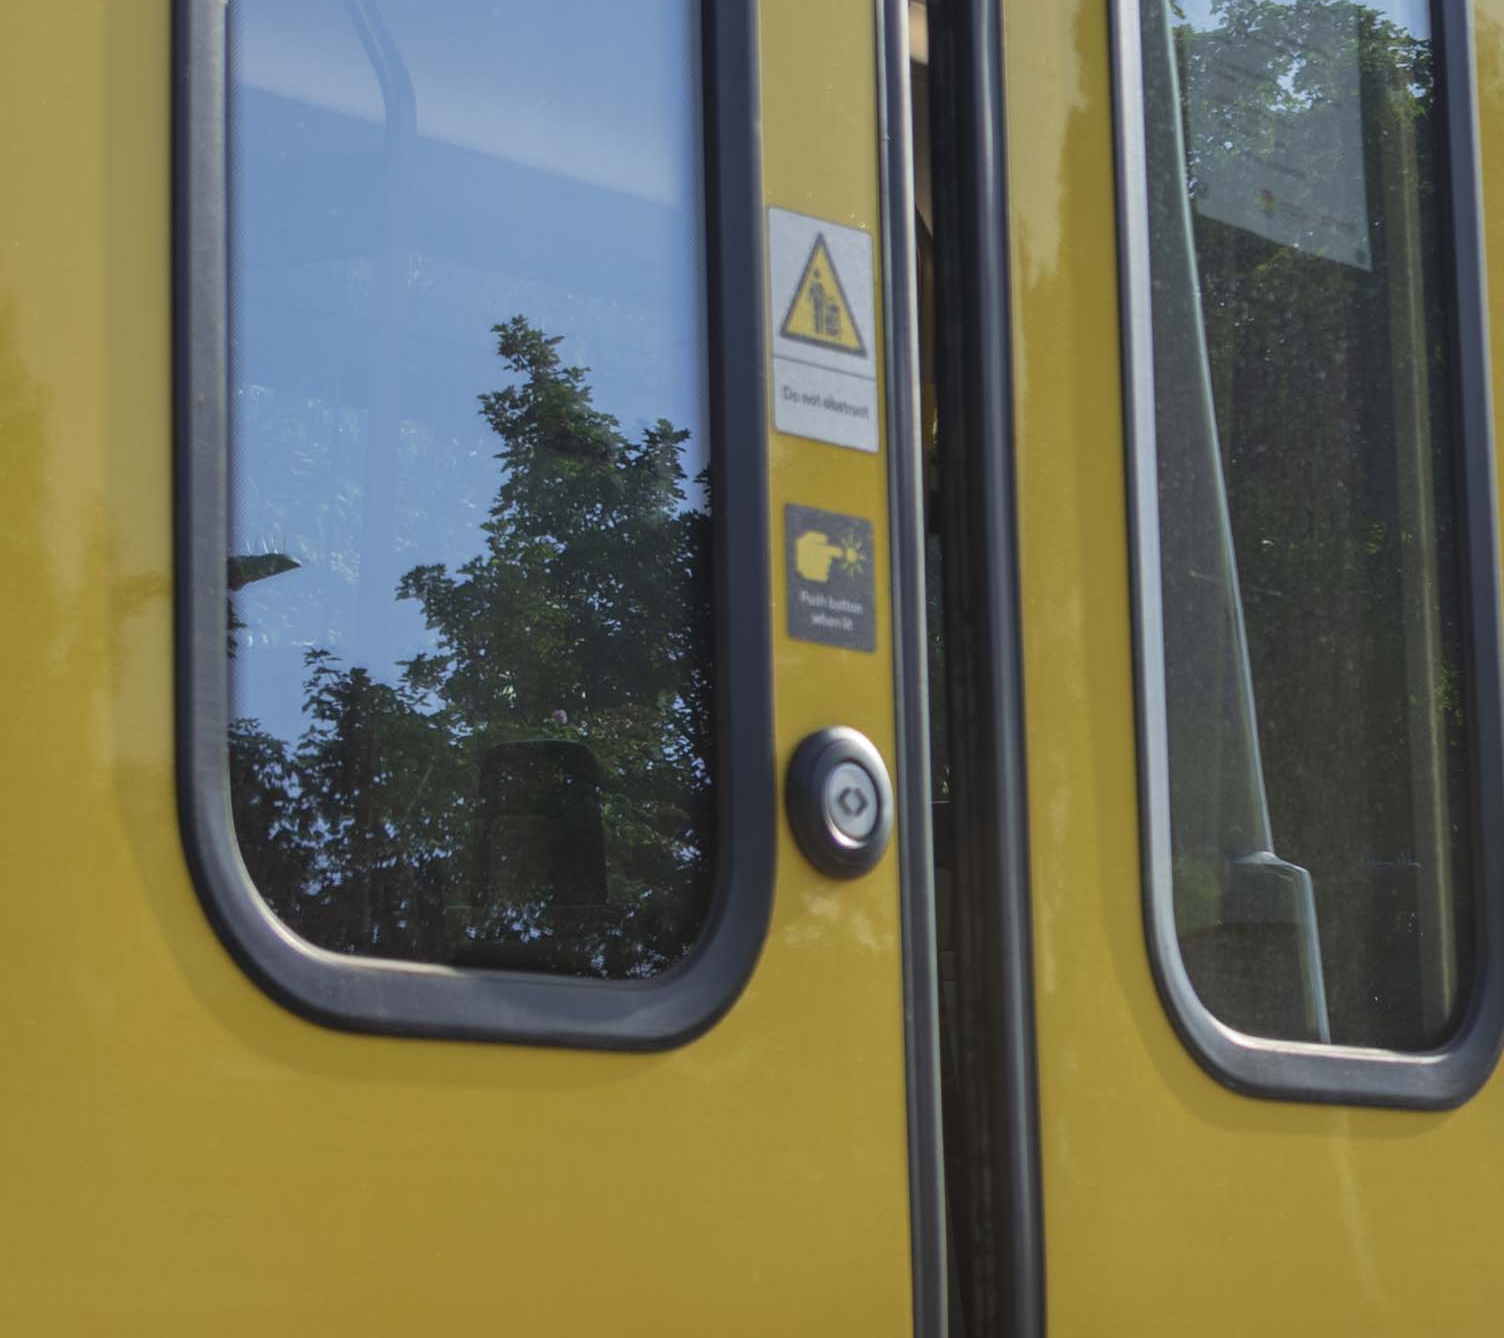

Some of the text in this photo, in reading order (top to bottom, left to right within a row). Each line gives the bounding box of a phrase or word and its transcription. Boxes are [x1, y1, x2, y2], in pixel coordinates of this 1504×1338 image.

[783, 385, 870, 419] Do not obstruct
[800, 590, 864, 614] Push button
